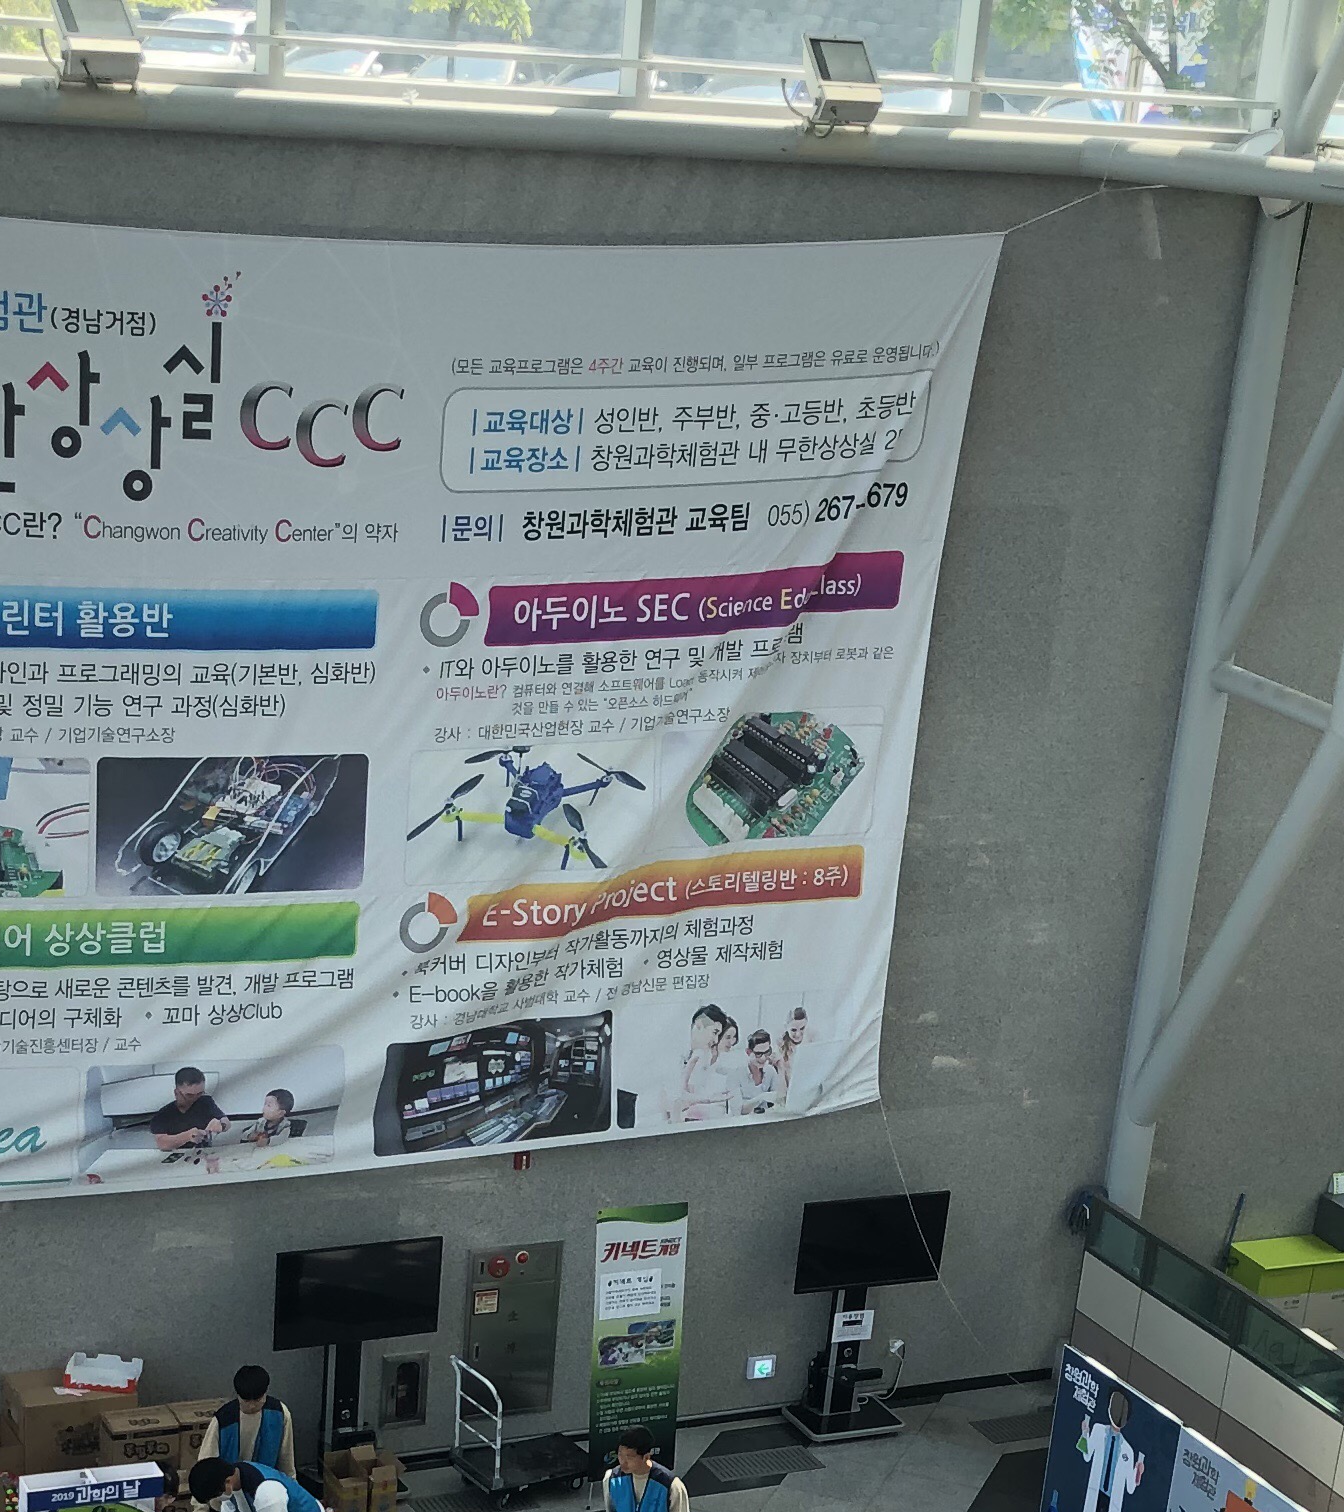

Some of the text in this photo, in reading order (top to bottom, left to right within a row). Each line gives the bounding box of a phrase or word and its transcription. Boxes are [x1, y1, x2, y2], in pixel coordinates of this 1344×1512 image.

[452, 358, 483, 376] (모든
[488, 358, 583, 376] 교육프로그램은
[589, 357, 623, 374] 4주간
[628, 354, 667, 374] 교육이
[673, 353, 727, 373] 진행되며,
[733, 352, 758, 372] 일부
[763, 349, 826, 369] 프로그램은
[831, 347, 867, 366] 유료로
[240, 380, 404, 467] CCC
[595, 404, 663, 435] 성인반,
[672, 401, 740, 432] 주부반,
[591, 440, 739, 474] 창원과학체험관
[749, 439, 767, 465] 내
[775, 433, 875, 463] 무한상상실
[188, 517, 267, 544] Creativity
[364, 522, 398, 543] 약자
[522, 510, 677, 542] 창원과학체험관
[685, 502, 750, 534] 교육팀
[77, 600, 173, 640] 활용반
[514, 595, 627, 632] 아두이노
[637, 593, 690, 623] SEC
[439, 657, 474, 680] IT와
[482, 651, 575, 678] 아두이노를
[582, 649, 637, 675] 활용한
[644, 646, 680, 671] 연구
[688, 644, 704, 669] 및
[709, 639, 743, 662] 개발
[873, 646, 894, 660] 같은
[57, 661, 182, 687] 프로그래밍의
[311, 662, 376, 688] 심화반)
[436, 682, 507, 702] 아두이노란?
[513, 680, 558, 699] 컴퓨터와
[512, 700, 533, 716] 것을
[538, 699, 559, 714] 만들
[563, 699, 573, 713] 수
[577, 695, 599, 713] 있는
[23, 693, 65, 718] 정밀
[74, 693, 113, 719] 기능
[123, 694, 163, 719] 연구
[172, 693, 286, 720] 과정(심화반)
[10, 724, 39, 744] 교수
[58, 726, 175, 746] 기업기술연구소장
[435, 727, 461, 743] 강사
[478, 721, 583, 740] 대한민국산업현장
[589, 719, 613, 736] 교수
[44, 921, 167, 957] 상상클럽
[476, 944, 559, 972] 디자인부터
[566, 922, 678, 956] 작가활동까지의
[684, 914, 754, 938] 체험과정
[505, 969, 548, 997] 활용한
[555, 958, 624, 980] 작가체험
[657, 946, 709, 970] 영상물
[714, 938, 785, 964] 제작체험
[56, 975, 111, 1000] 새로운
[116, 973, 190, 999] 콘텐츠를
[197, 971, 237, 996] 발견,
[244, 969, 278, 994] 개발
[283, 968, 354, 992] 프로그램
[64, 1006, 122, 1030] 구체화
[163, 1006, 200, 1027] 꼬마
[208, 1001, 283, 1024] 상상Club
[410, 1013, 437, 1030] 강사
[564, 988, 590, 1003] 교수
[673, 973, 710, 991] 편집장
[114, 1036, 141, 1054] 교수
[600, 1239, 659, 1263] 키넥트
[51, 1480, 141, 1504] 2019 과학의 날
